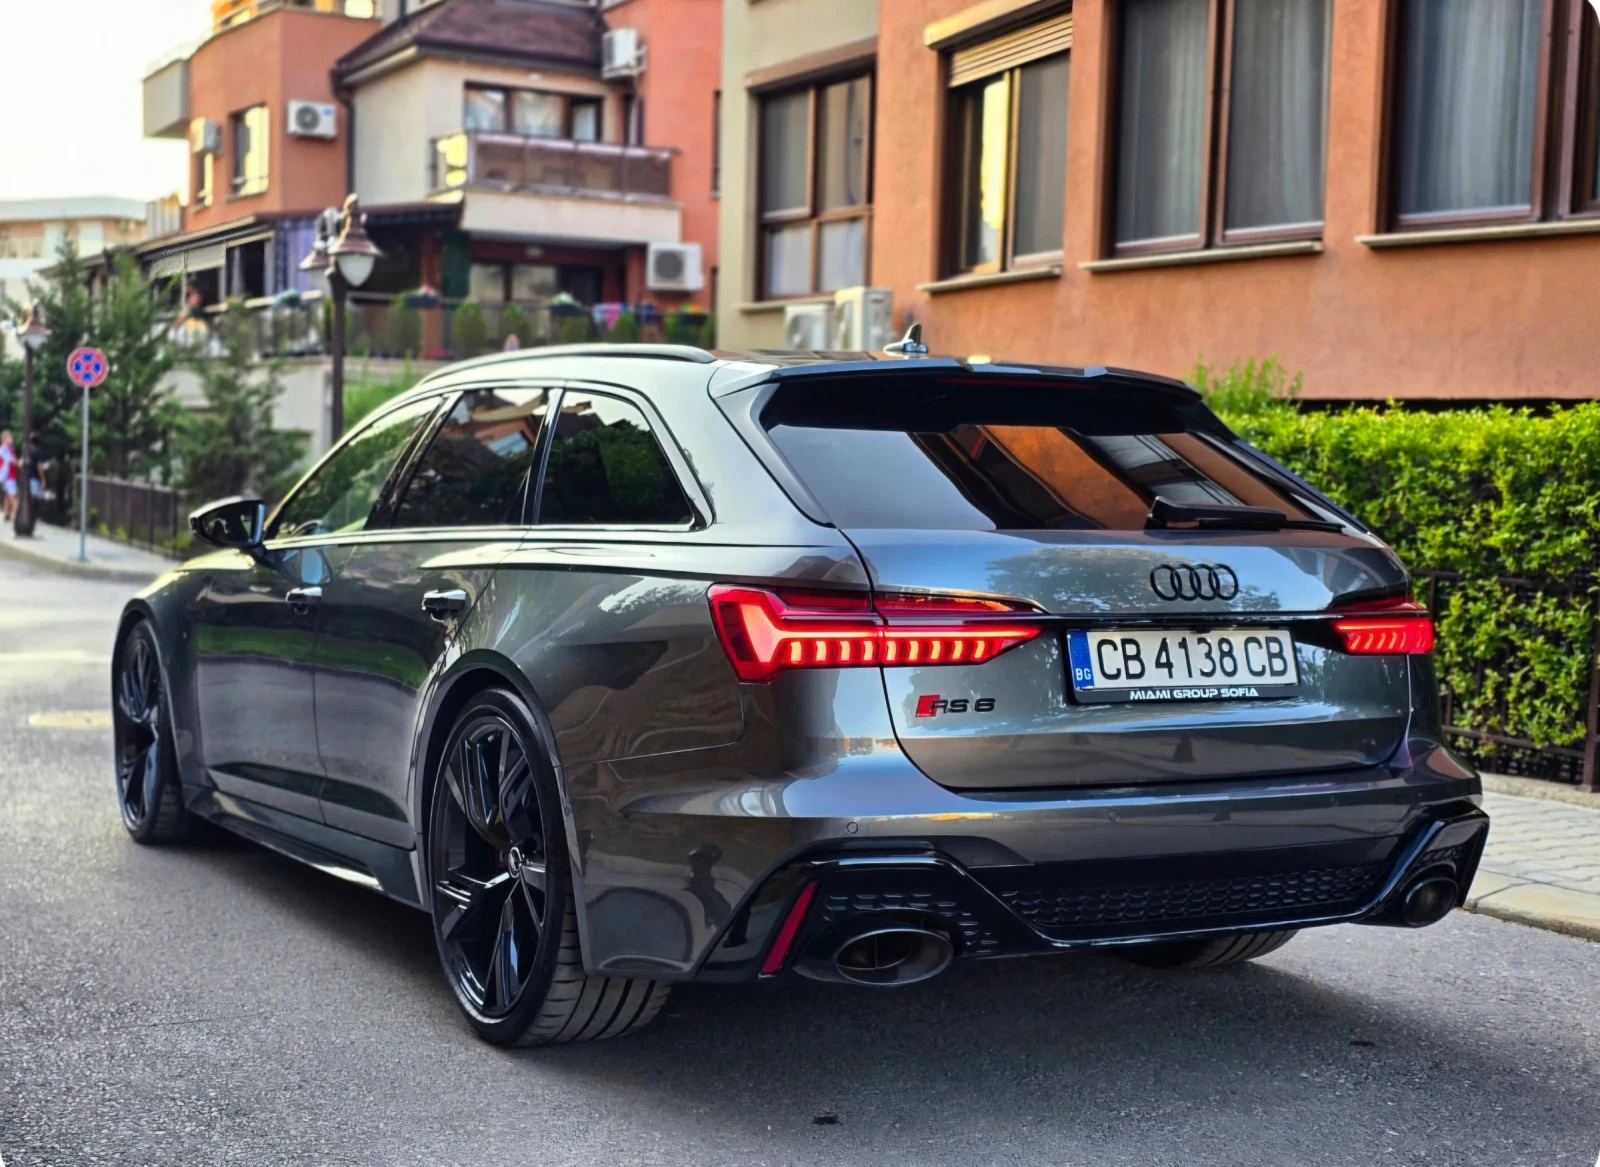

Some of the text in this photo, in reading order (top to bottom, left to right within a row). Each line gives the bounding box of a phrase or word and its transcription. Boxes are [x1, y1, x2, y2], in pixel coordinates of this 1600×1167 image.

[1097, 636, 1288, 680] CB 4138 CB
[1075, 668, 1092, 681] BG
[1130, 687, 1259, 700] MIAMI GROUP SOFIA
[930, 698, 996, 714] RS 6
